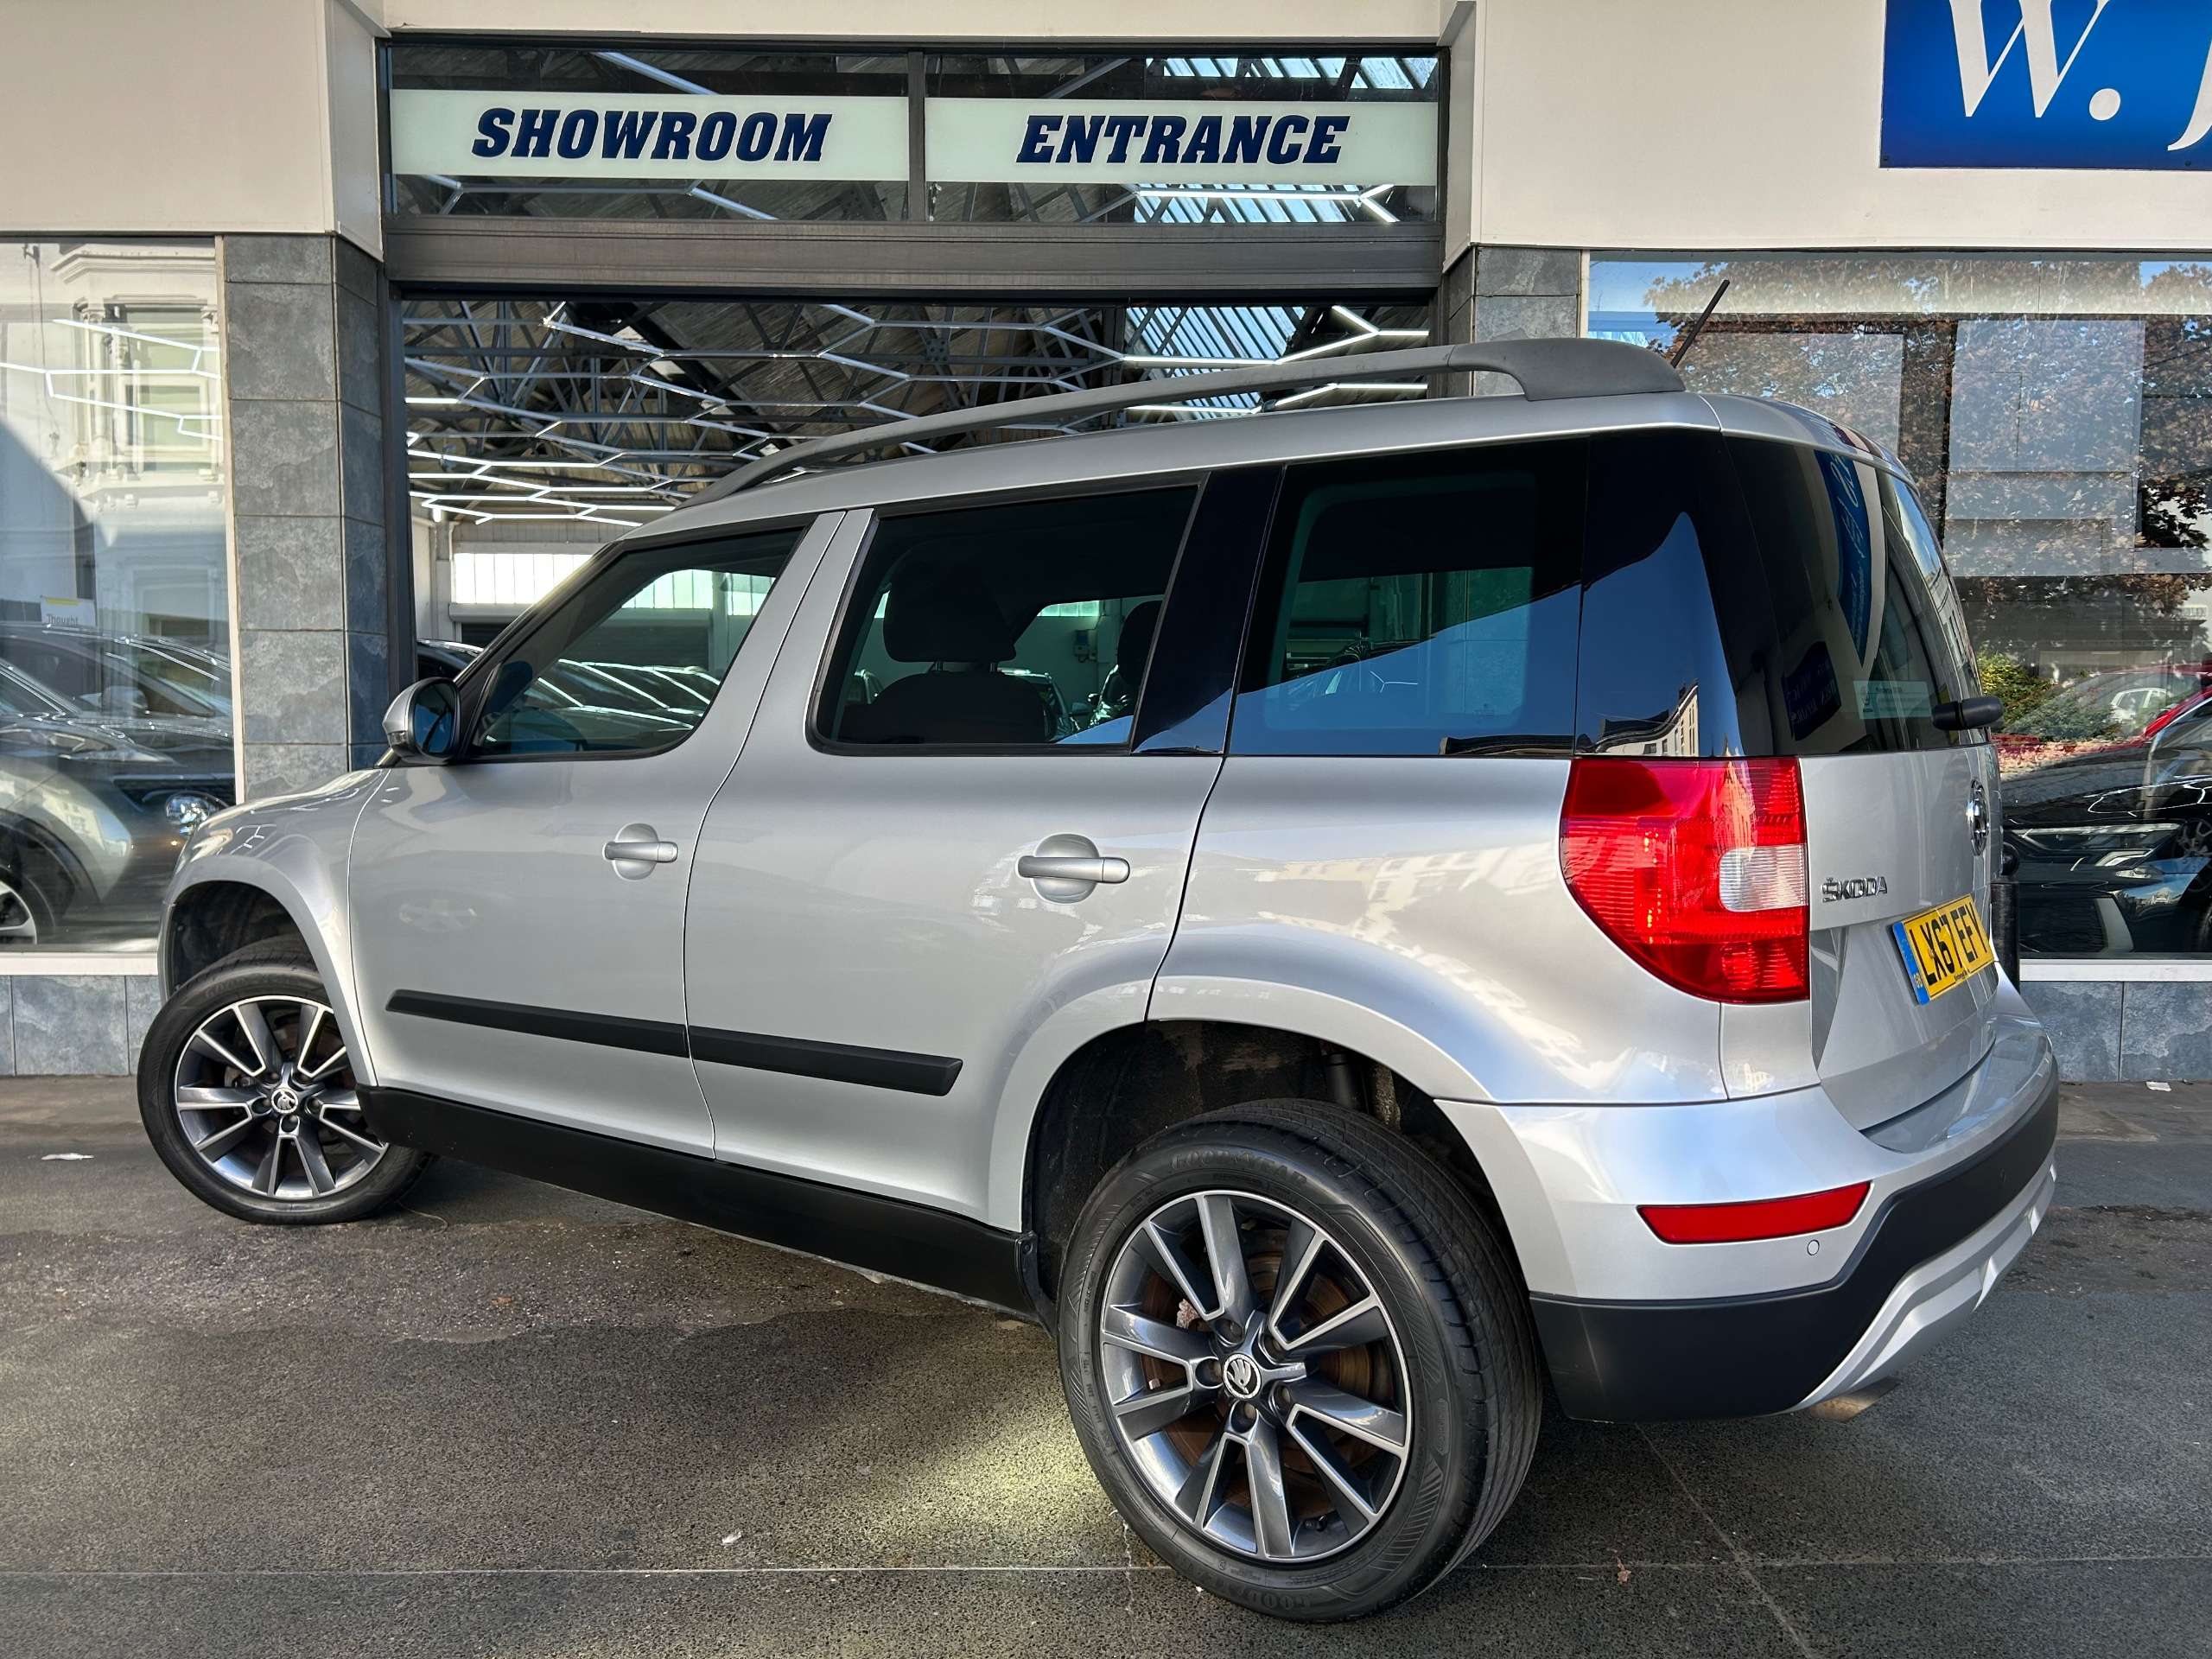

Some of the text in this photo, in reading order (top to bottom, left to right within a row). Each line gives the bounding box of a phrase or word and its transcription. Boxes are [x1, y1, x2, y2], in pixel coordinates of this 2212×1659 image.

[1948, 0, 2121, 121] W.
[471, 108, 832, 162] SHOWROOM
[1016, 115, 1351, 165] ENTRANCE
